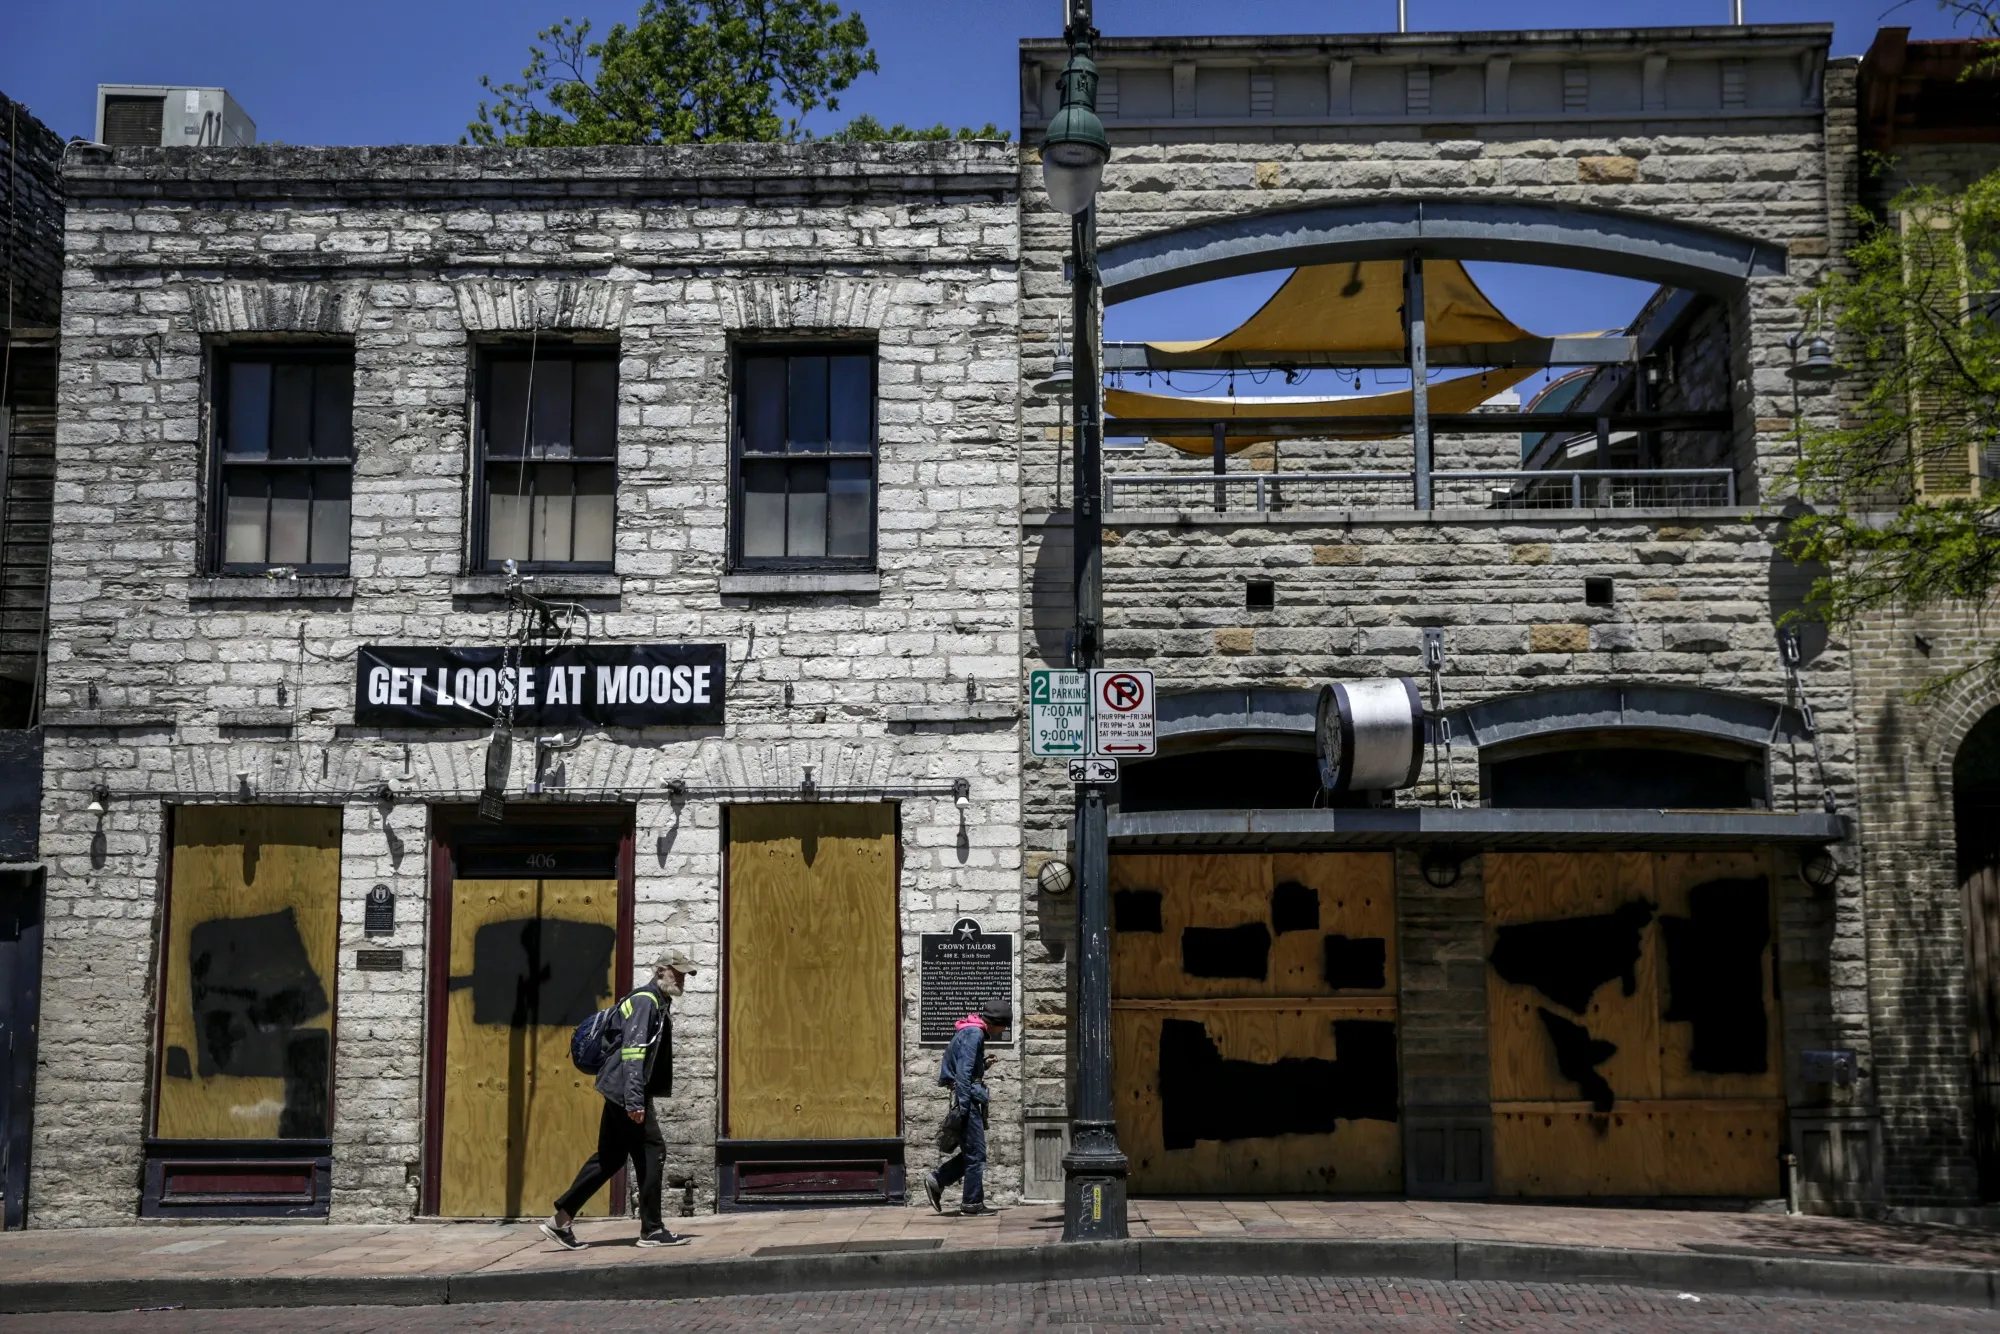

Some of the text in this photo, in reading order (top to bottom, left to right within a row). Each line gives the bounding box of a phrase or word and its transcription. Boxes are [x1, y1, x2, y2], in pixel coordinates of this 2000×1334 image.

[369, 665, 711, 706] GET LOOSE AT MOOSE
[1034, 675, 1079, 699] 2 HOUR
[1052, 688, 1087, 699] PARKING
[1041, 706, 1082, 717] 7:00AM
[1055, 718, 1068, 729] TO
[1040, 730, 1083, 741] 9:00PM
[526, 853, 556, 868] 406
